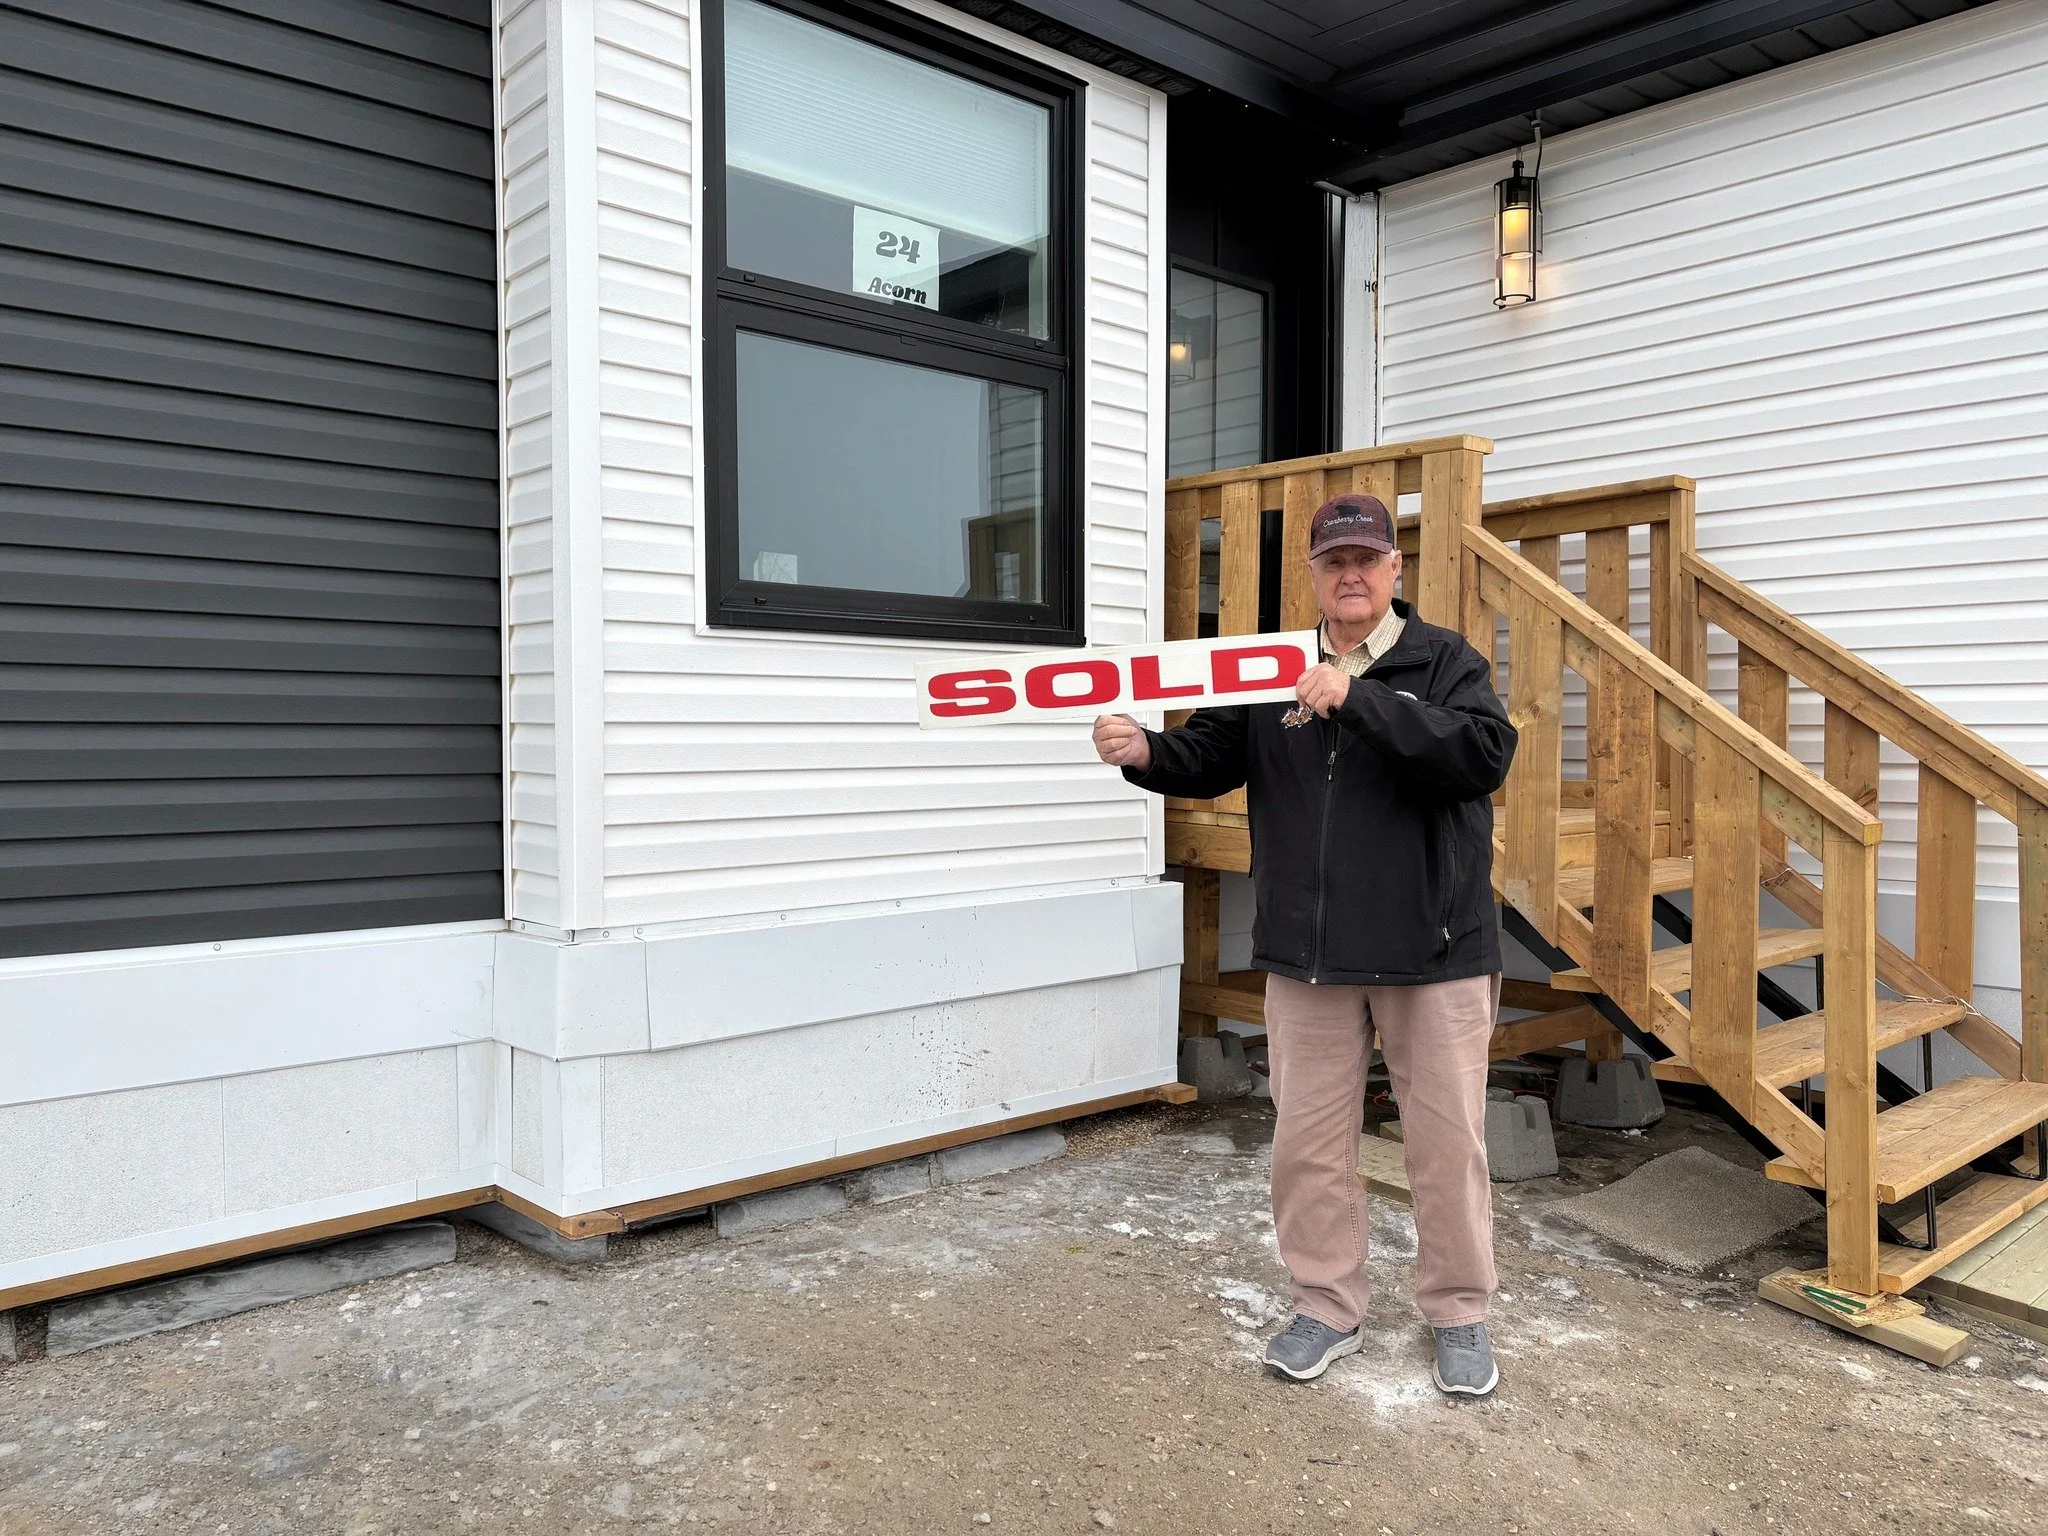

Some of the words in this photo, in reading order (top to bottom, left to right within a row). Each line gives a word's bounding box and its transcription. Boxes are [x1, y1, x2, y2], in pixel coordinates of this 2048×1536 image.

[875, 231, 921, 264] 24
[867, 276, 927, 304] Acorn
[1323, 515, 1354, 528] Cranberry
[1355, 513, 1374, 523] Creek
[928, 644, 1306, 718] SOLD
